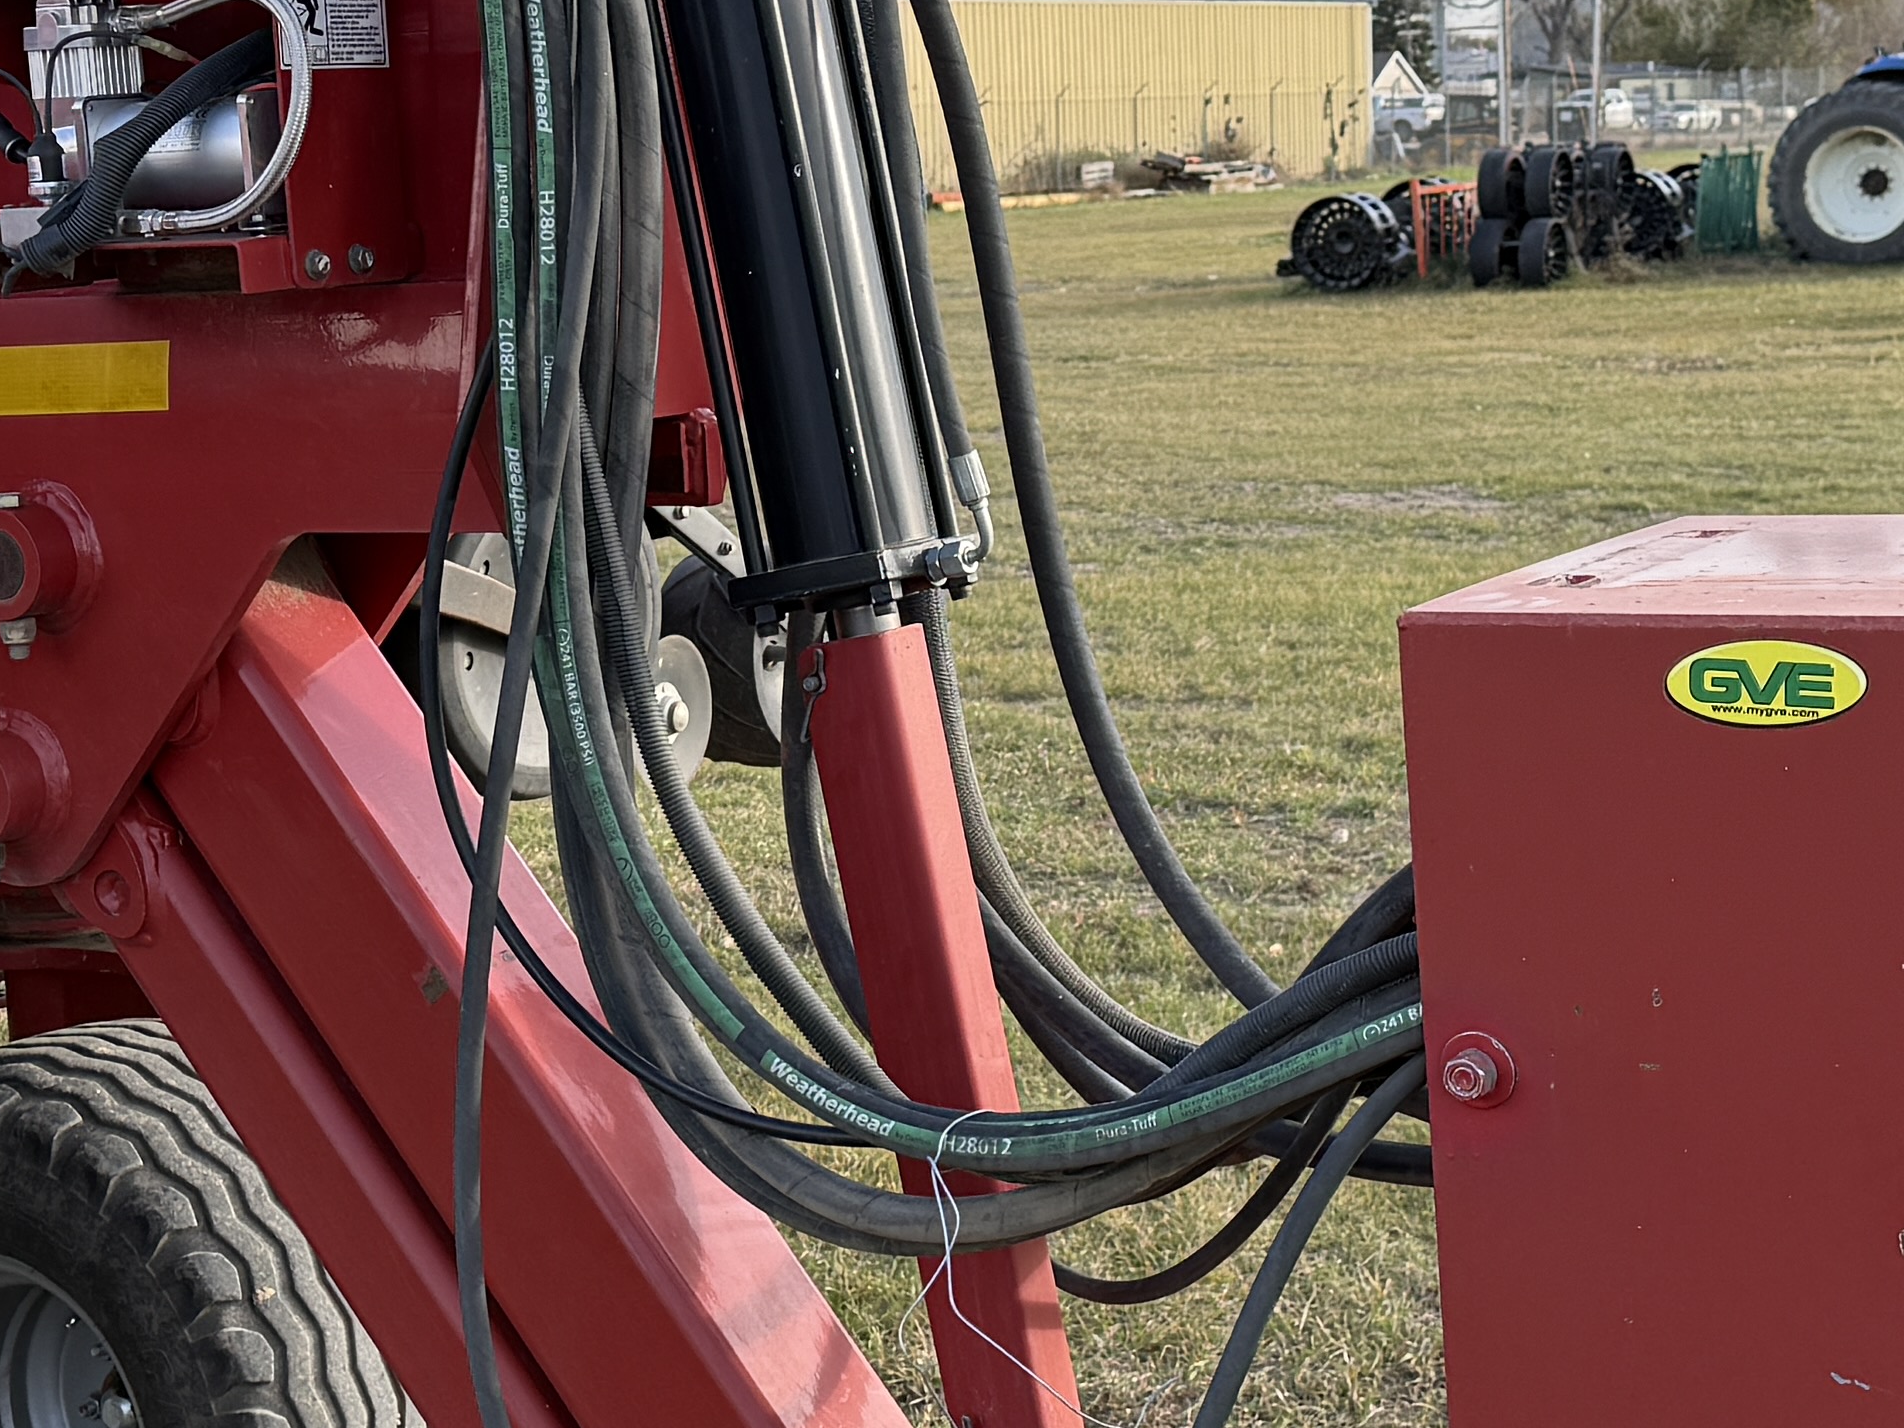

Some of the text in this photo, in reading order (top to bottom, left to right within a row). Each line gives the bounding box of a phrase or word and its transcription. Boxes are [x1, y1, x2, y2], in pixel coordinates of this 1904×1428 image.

[494, 163, 510, 229] Dura-Tuff
[539, 190, 556, 265] H28012
[498, 317, 516, 391] H28012
[559, 645, 573, 669] 241
[564, 673, 577, 701] BAR
[1689, 657, 1835, 710] GVE
[569, 702, 586, 739] (3500
[1711, 704, 1820, 719] www.mygve.com
[1380, 1012, 1404, 1032] 241
[768, 1056, 896, 1138] Weatherhead
[943, 1134, 1012, 1156] H28012
[1095, 1111, 1158, 1142] Dura-Tuff
